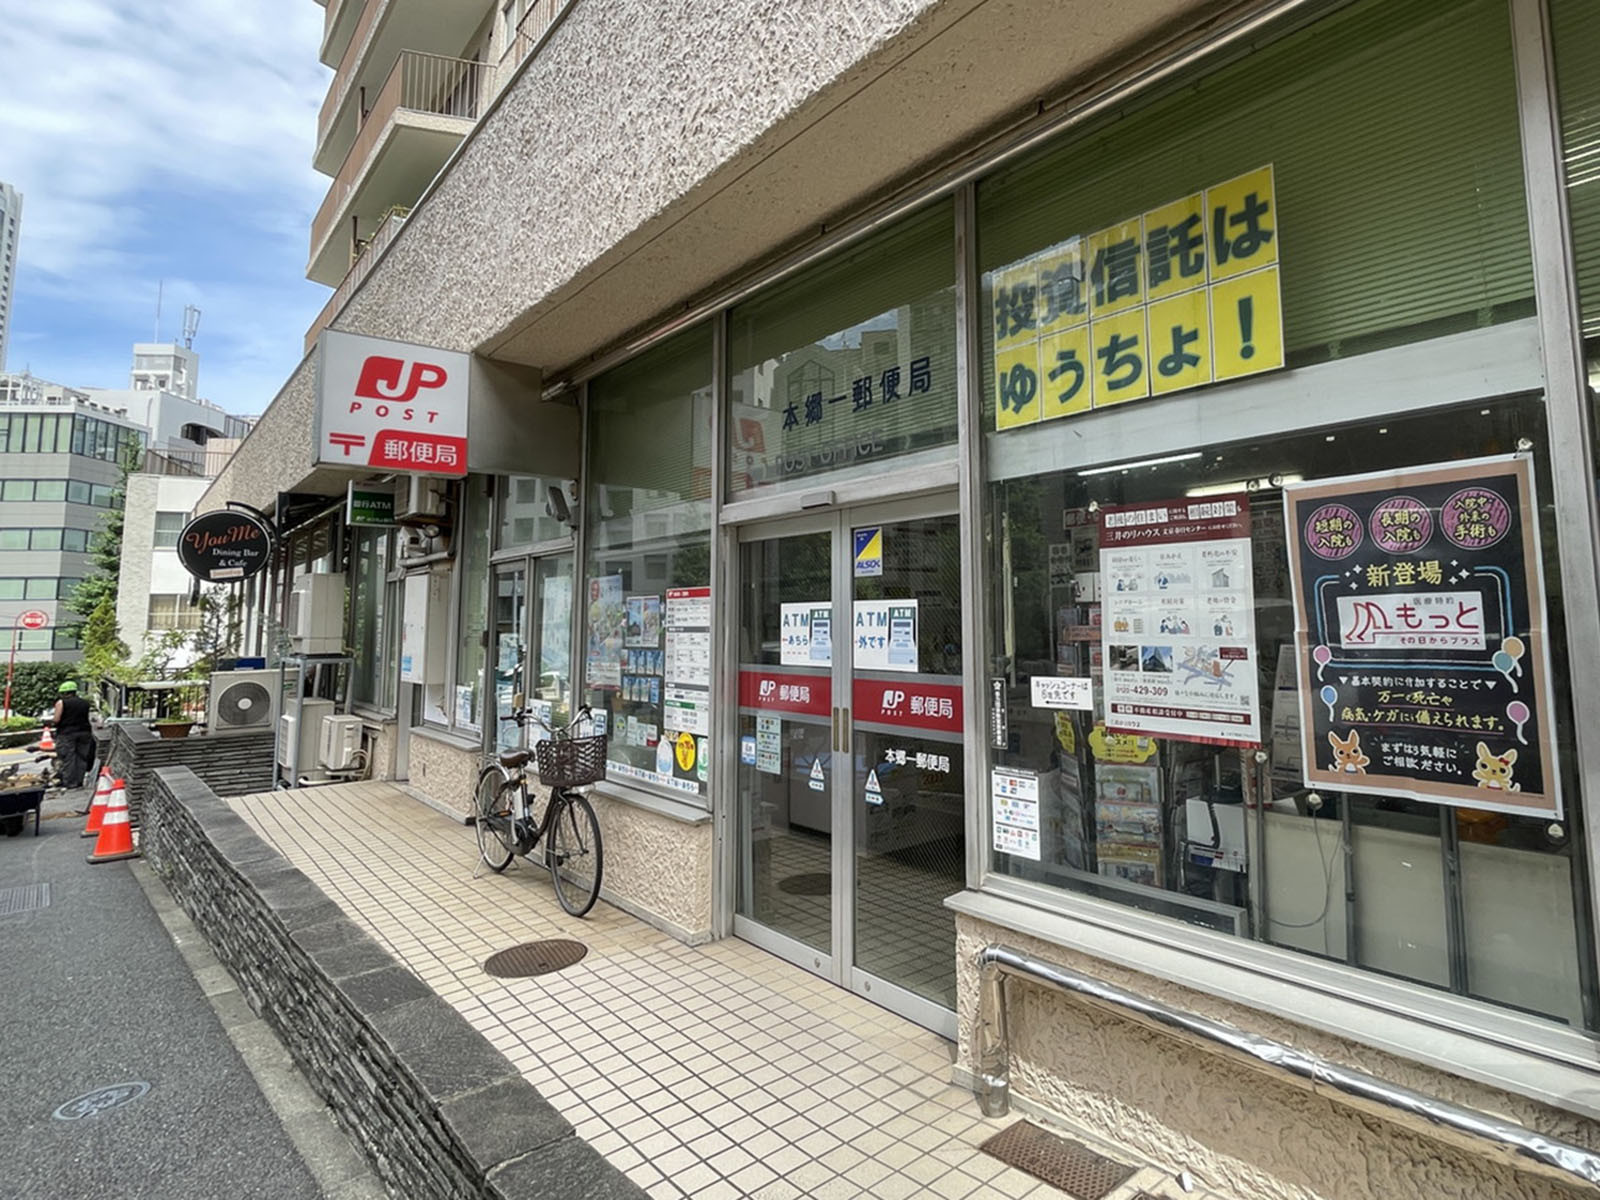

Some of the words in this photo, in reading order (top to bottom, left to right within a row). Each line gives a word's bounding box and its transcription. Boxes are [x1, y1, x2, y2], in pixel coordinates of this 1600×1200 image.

[995, 192, 1274, 341] 投資信託は
[1000, 295, 1256, 414] ゆうちょ！
[355, 356, 448, 402] JP
[783, 357, 931, 430] 本郷一郵便局
[349, 402, 439, 423] POST
[384, 439, 457, 466] 郵便局
[1380, 511, 1421, 527] 長期の
[1459, 511, 1490, 522] 外来の
[1315, 518, 1354, 534] 短期の
[1454, 522, 1497, 540] 手術も
[1317, 534, 1354, 549] 入院も
[1382, 527, 1422, 543] 入院も
[212, 547, 241, 557] Dining
[243, 548, 259, 557] Bar
[856, 560, 880, 568] ALSOK
[1367, 561, 1443, 588] 新登場
[783, 613, 809, 627] ATM
[814, 610, 829, 618] ATM
[856, 612, 887, 627] ATM
[893, 609, 912, 618] ATM
[1396, 601, 1479, 629] もっと
[788, 635, 808, 646] あちら
[859, 635, 886, 649] 外です
[1400, 636, 1480, 645] その日からプラス
[759, 680, 776, 696] JP
[779, 685, 810, 703] 郵便局
[882, 690, 905, 709] JP
[910, 695, 953, 719] 郵便局
[1381, 742, 1457, 759] まずはお気軽に
[885, 748, 950, 773] 本郷一郵便局
[1383, 755, 1462, 775] ご相談ください。
